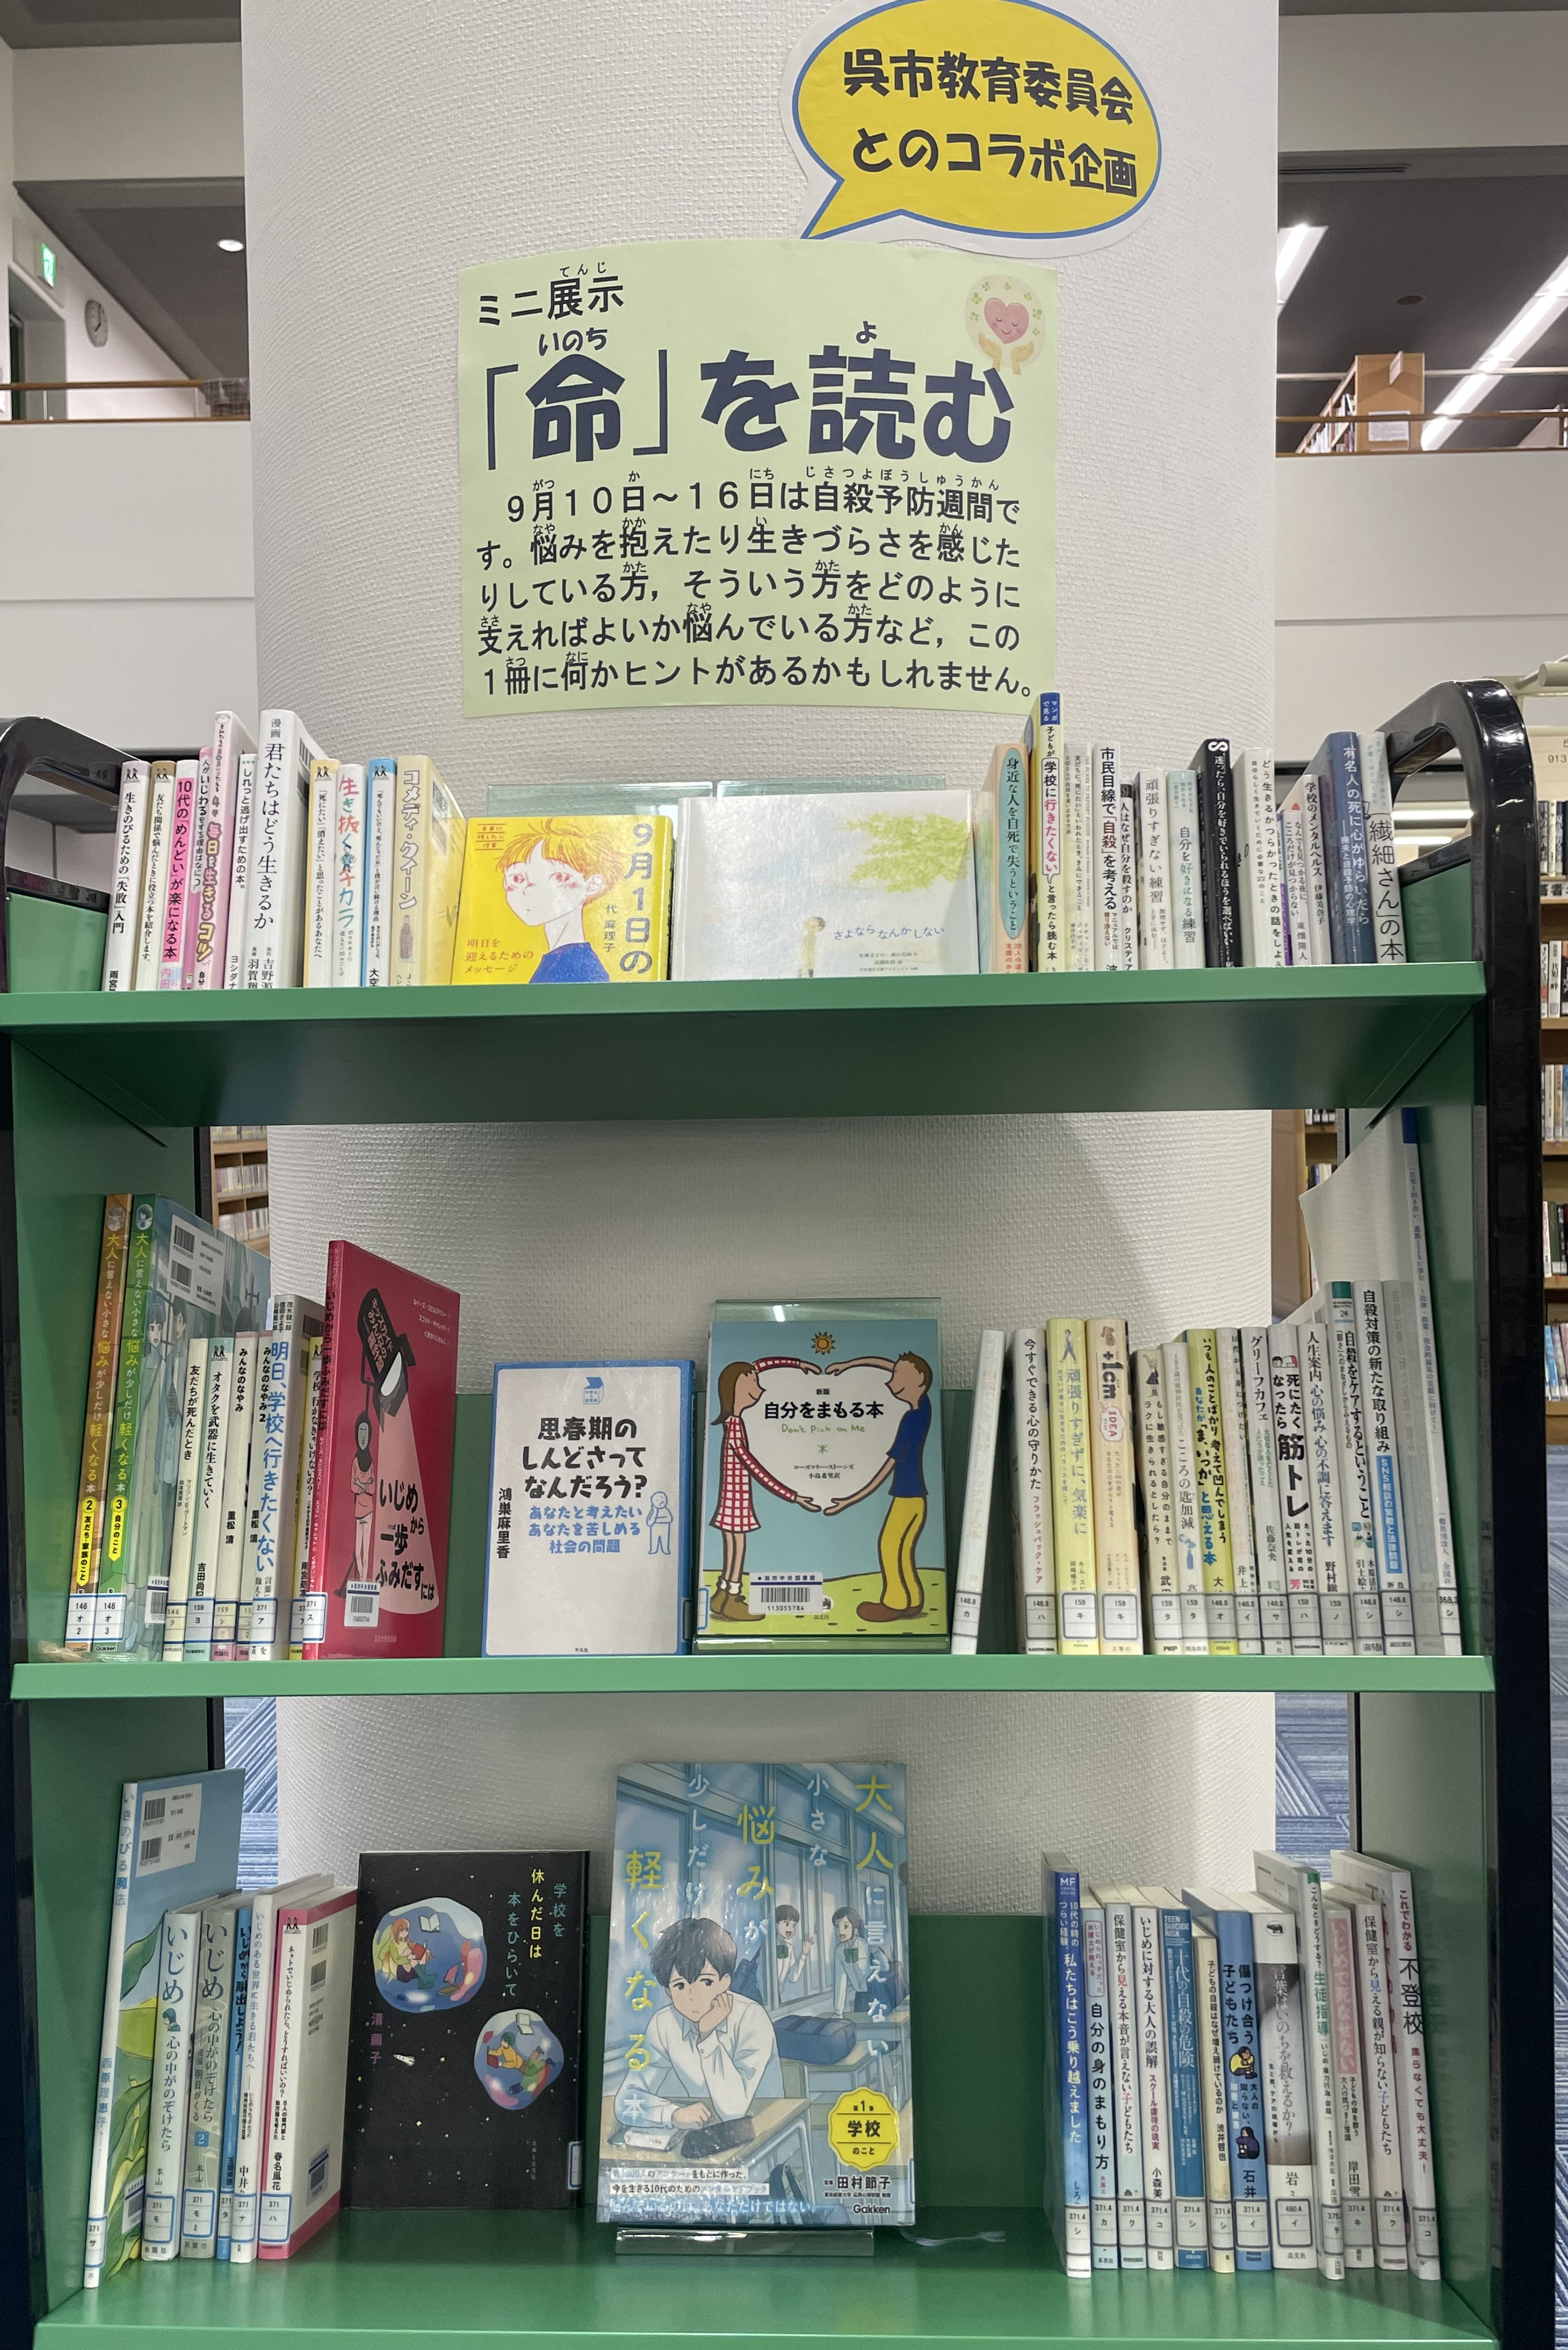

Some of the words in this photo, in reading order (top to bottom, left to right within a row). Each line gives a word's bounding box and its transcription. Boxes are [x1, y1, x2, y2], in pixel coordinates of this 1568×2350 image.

[843, 49, 1133, 124] 呉市教育委員会
[852, 128, 1137, 198] とのコラボ企画
[479, 276, 624, 326] ミニ展示
[539, 328, 608, 356] いのち
[487, 345, 1014, 470] 「命」を読む
[253, 743, 285, 930] 君たちはどう生きるか
[1006, 758, 1020, 931] 身近な人を自死で失うということ
[1145, 778, 1164, 903] 頑張りすぎない練習
[1305, 782, 1322, 877] 学校のメンタルヘルス
[619, 823, 653, 974] 9月1日の
[1179, 826, 1196, 943] 自分を好きになる練習
[235, 1348, 248, 1412] みんなのなやみ
[764, 1401, 885, 1419] 自分をまもる本
[1250, 1335, 1268, 1420] グリーフカフェ
[1363, 1289, 1390, 1453] 自殺対策の新たな取り組み
[184, 1365, 201, 1461] 友だちが死んだとき
[203, 1371, 223, 1508] オタクを武器に生きていく
[537, 1416, 637, 1441] 思春期の
[1024, 1339, 1042, 1490] 今すぐできる心の守りかた
[256, 1341, 289, 1572] 明日、学校へ行きたくない
[379, 1479, 418, 1514] いじめ
[522, 1445, 647, 1470] しんどさって
[528, 1505, 642, 1519] あなたと考えたい
[528, 1522, 640, 1537] あなたを苦しめる
[549, 1539, 621, 1554] 社会の問題
[808, 1773, 829, 1867] 小さな
[504, 1892, 522, 1996] 本をひらいて
[529, 1868, 545, 1959] 休んだ日は
[552, 1883, 567, 1938] 学校を
[162, 1926, 188, 2004] いじめ
[202, 1923, 228, 2001] いじめ
[1140, 1916, 1158, 2068] いじめに対する大人の誤解
[1398, 1958, 1424, 2035] 不登校
[1222, 1964, 1239, 2045] 子どもたち
[1238, 1964, 1254, 2045] 傷つけ合う
[1063, 1954, 1081, 2144] 私たちはこう乗り越えました
[1090, 2003, 1109, 2170] 自分の身のまもり方
[160, 2035, 181, 2152] 心の中がのぞけたら
[847, 2120, 881, 2138] 学校
[837, 2176, 892, 2190] 田村節子
[852, 2147, 875, 2155] のこと
[853, 2204, 891, 2214] Gakken
